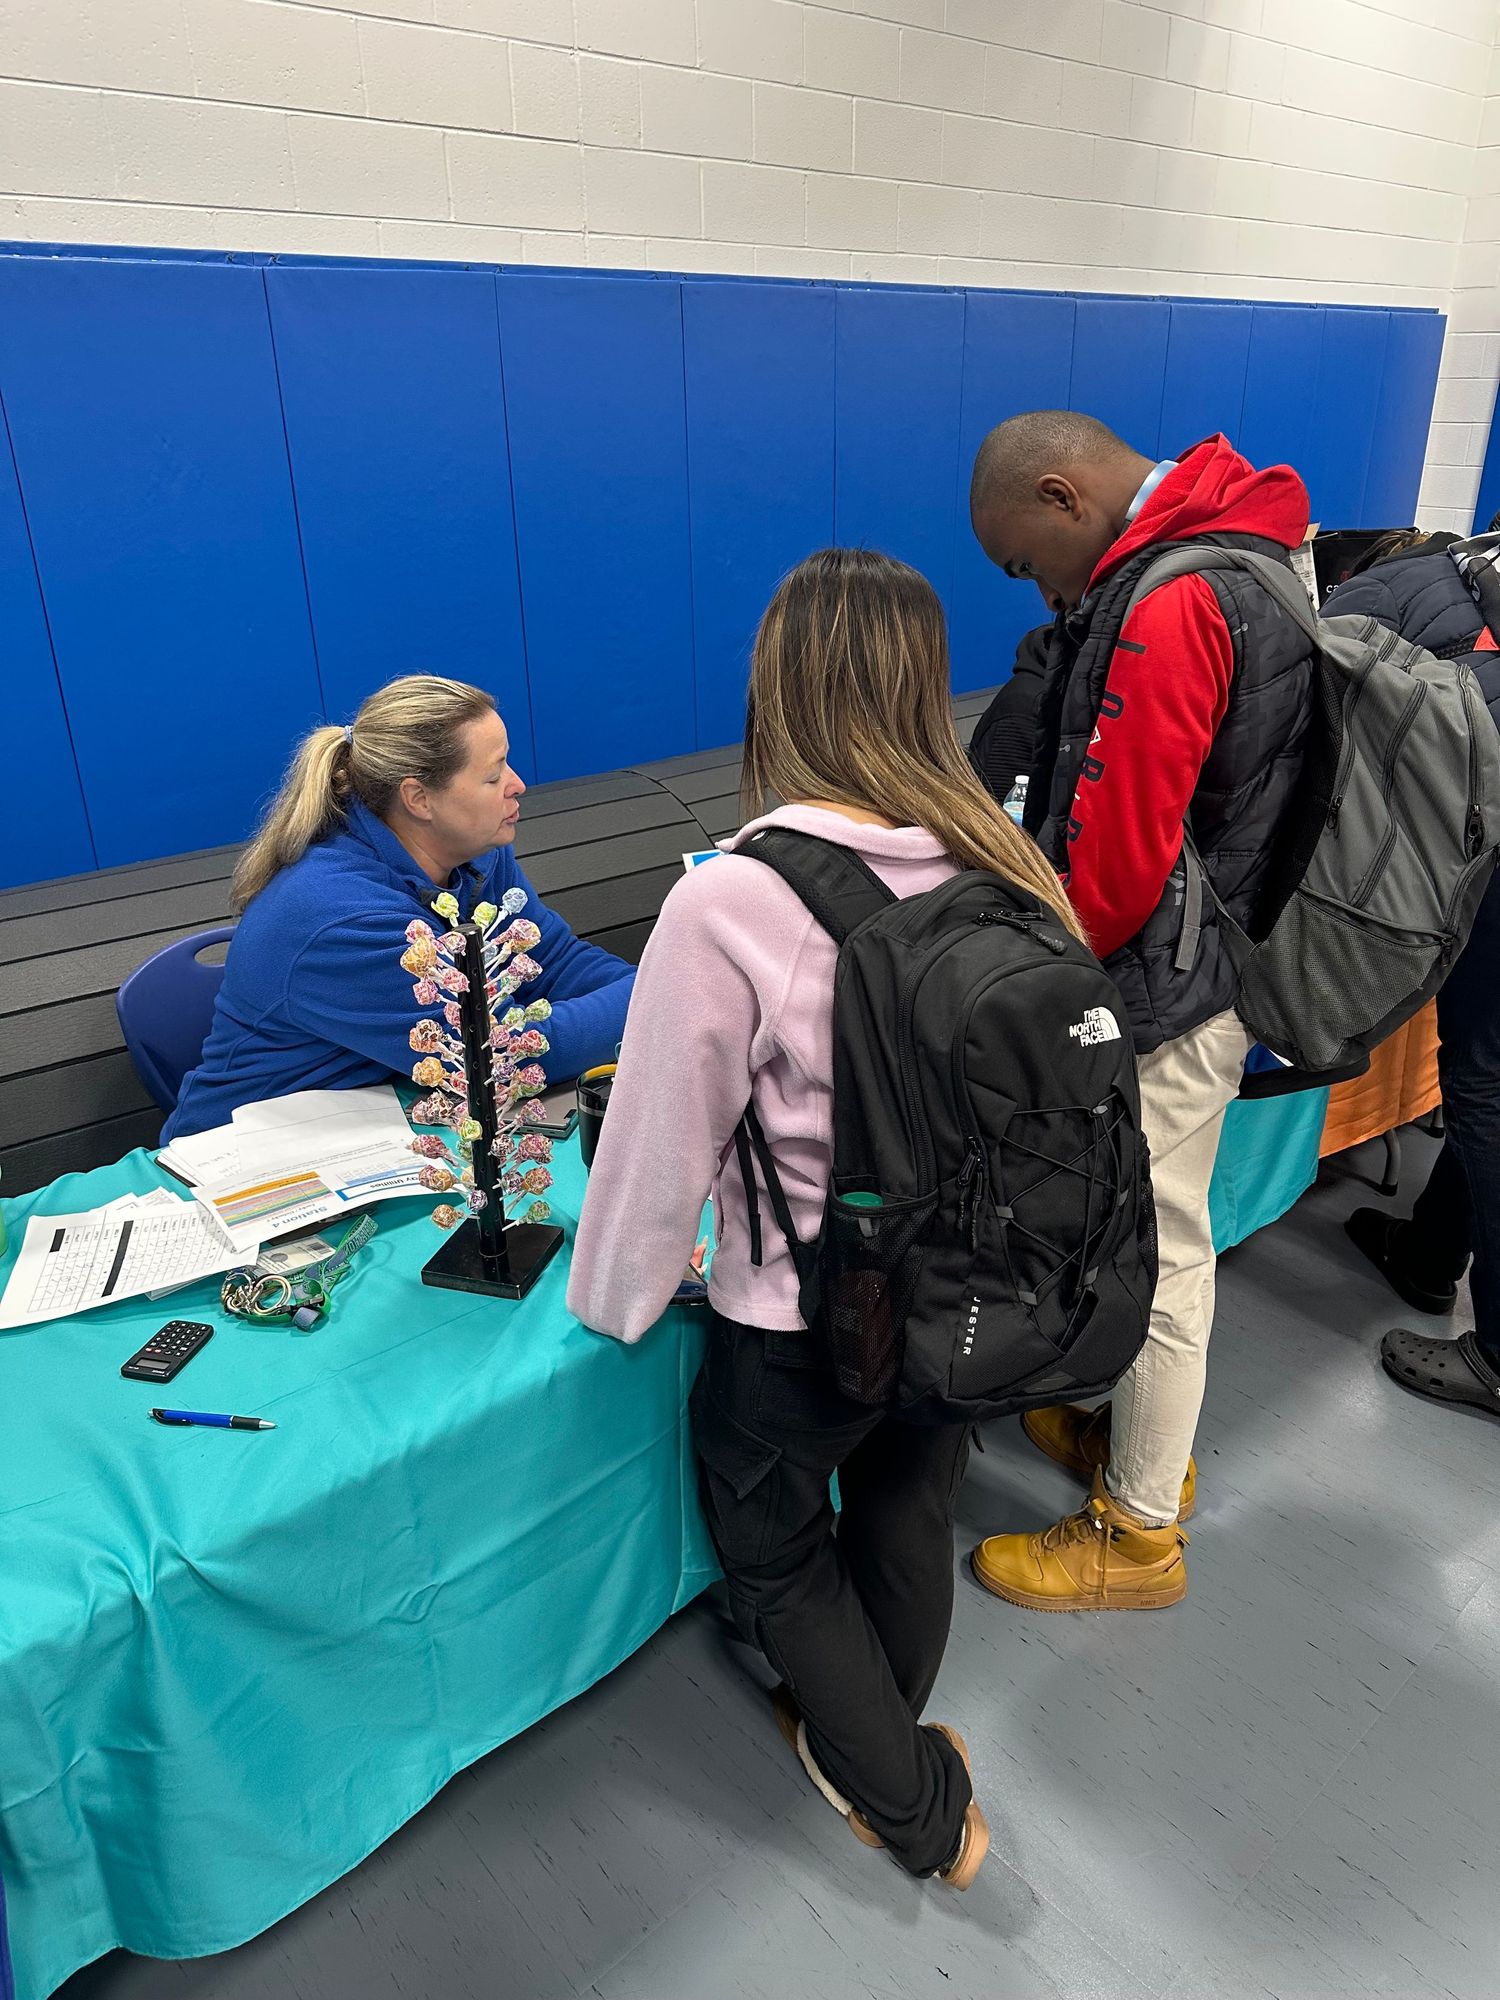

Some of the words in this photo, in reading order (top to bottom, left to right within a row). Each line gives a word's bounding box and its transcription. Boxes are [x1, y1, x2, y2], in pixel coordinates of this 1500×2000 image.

[1083, 1009, 1100, 1022] THE
[1069, 1019, 1103, 1038] NORTH
[1080, 1030, 1106, 1047] FACE
[282, 1206, 328, 1224] Station
[962, 1296, 981, 1355] JESTER
